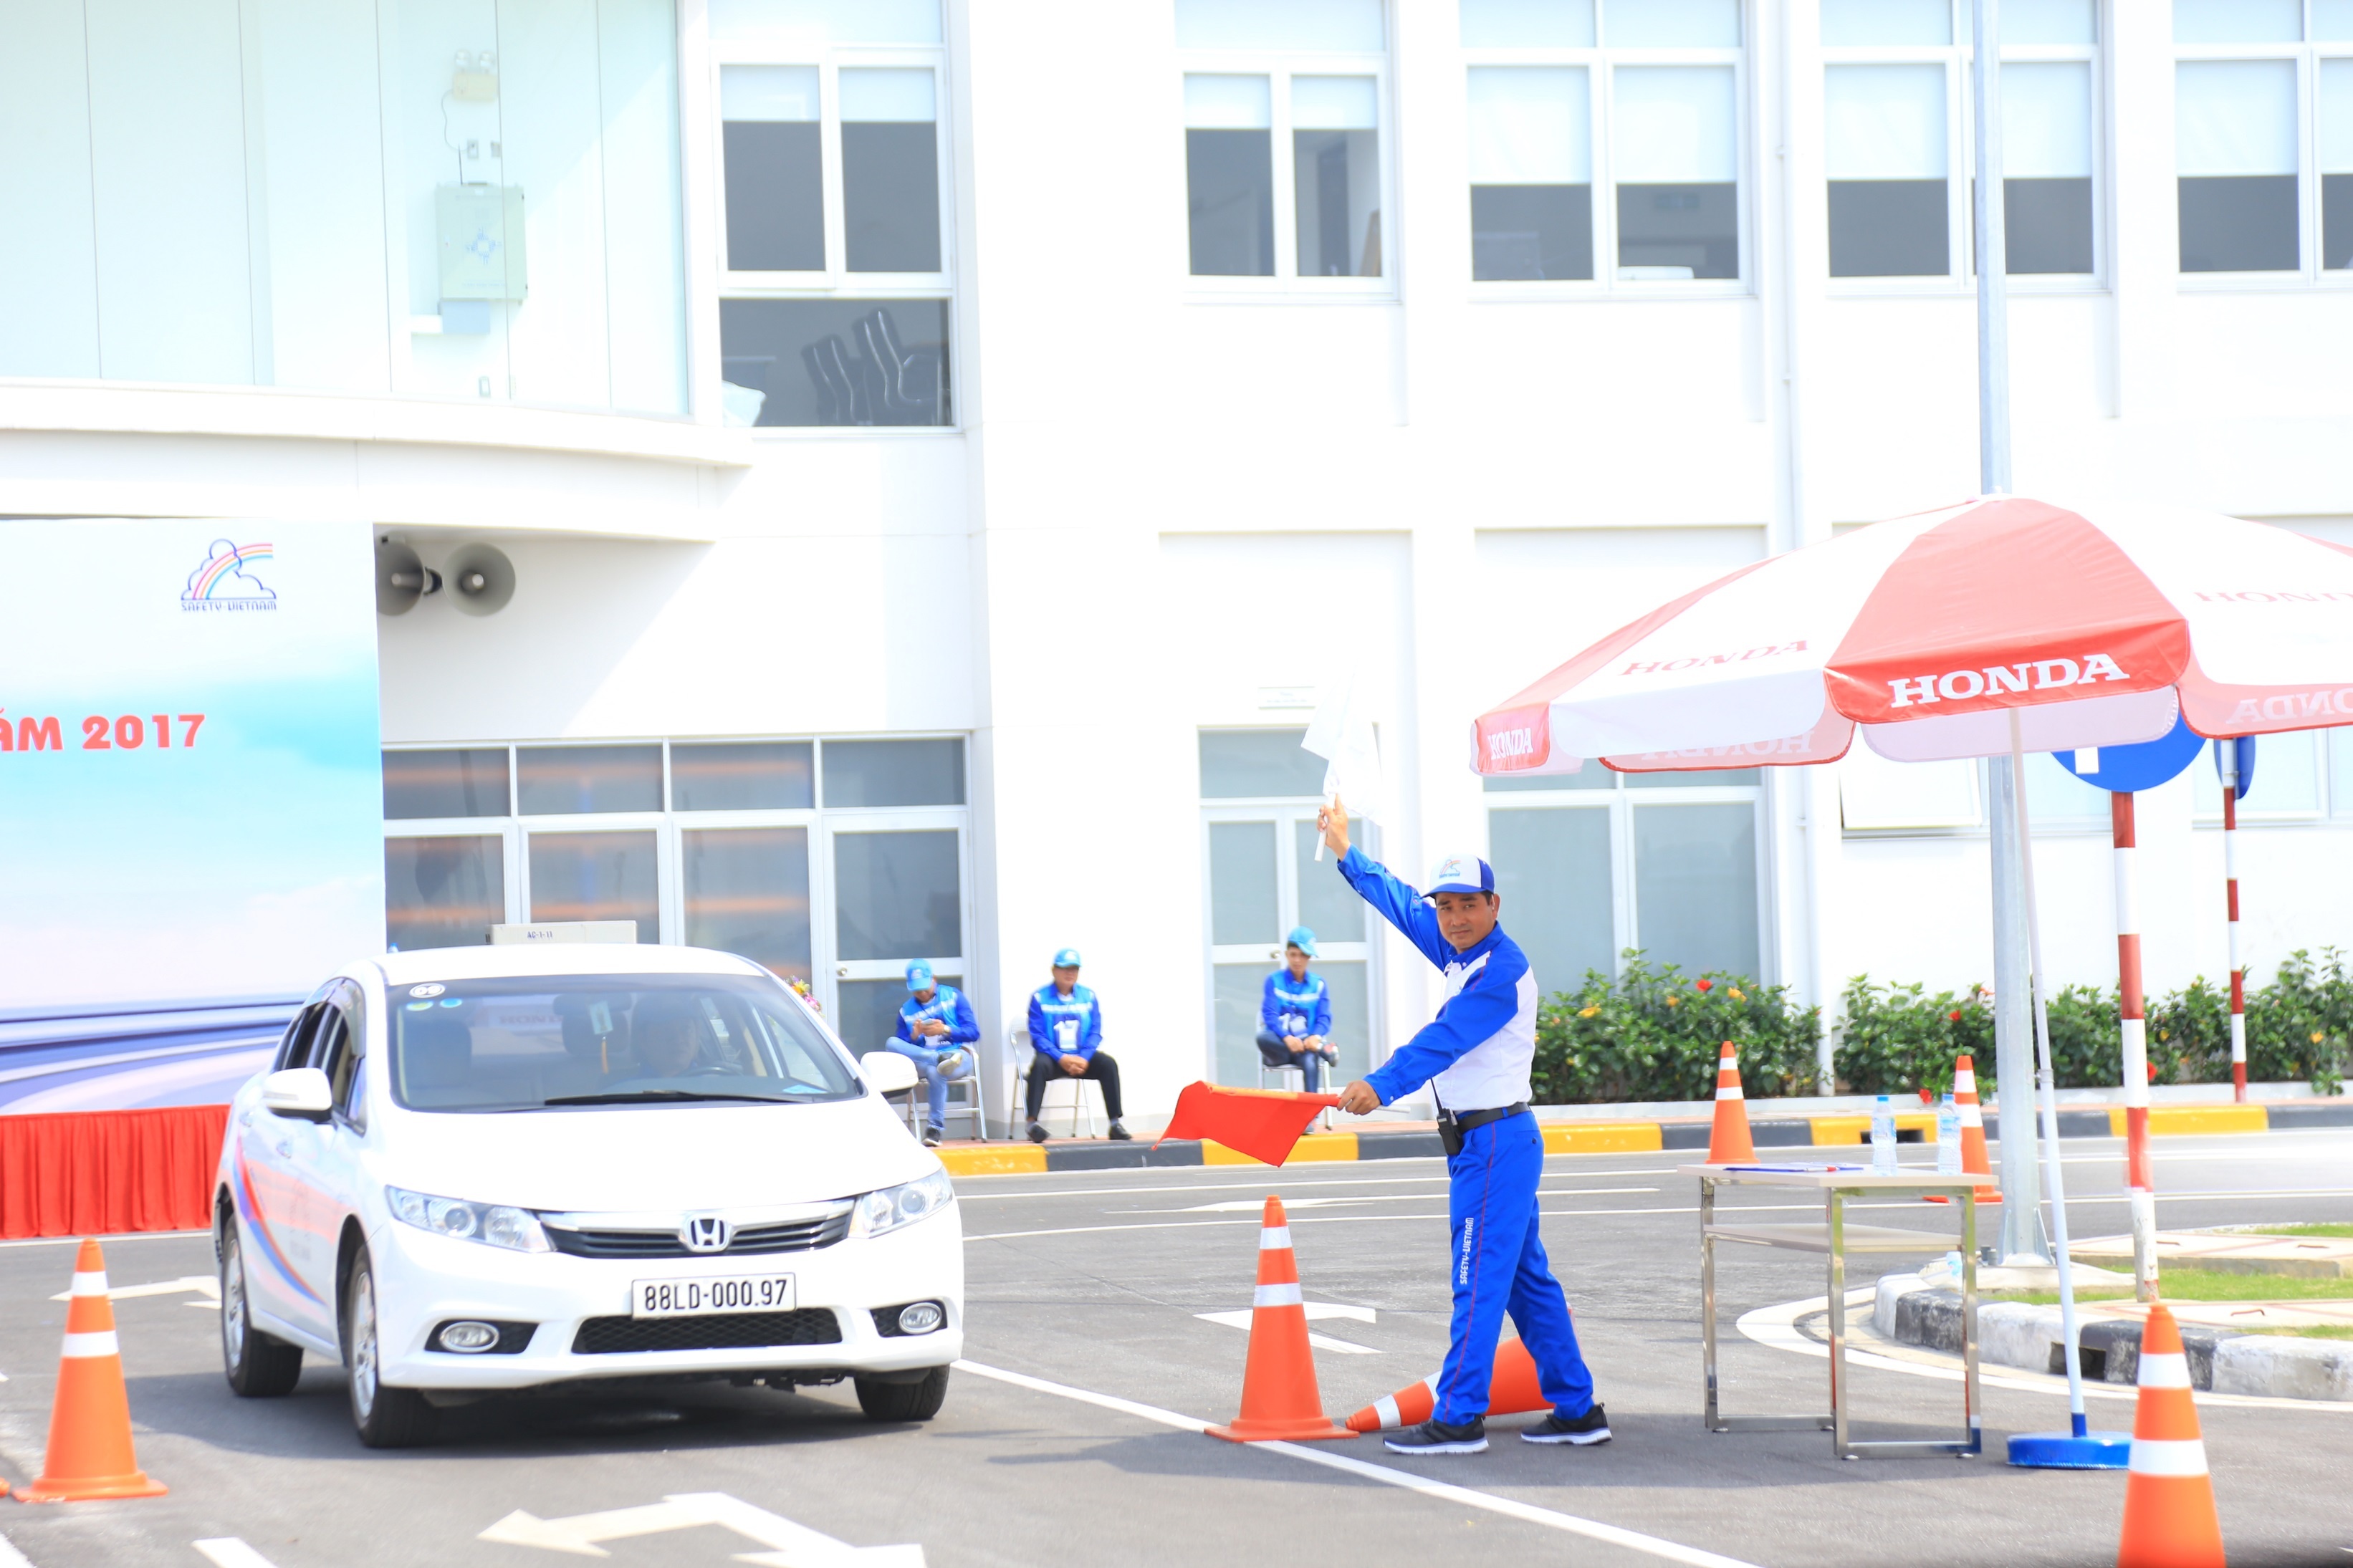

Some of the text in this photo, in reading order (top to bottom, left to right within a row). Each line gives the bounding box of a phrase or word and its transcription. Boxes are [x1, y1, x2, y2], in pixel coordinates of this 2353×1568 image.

[1617, 640, 1808, 676] HONDA
[1887, 653, 2130, 708] HONDA
[82, 714, 206, 750] 2017
[1487, 727, 1534, 760] HONDA
[1460, 1217, 1474, 1285] SAFETY-VIETNAM
[645, 1279, 787, 1311] 88LD-000.97
